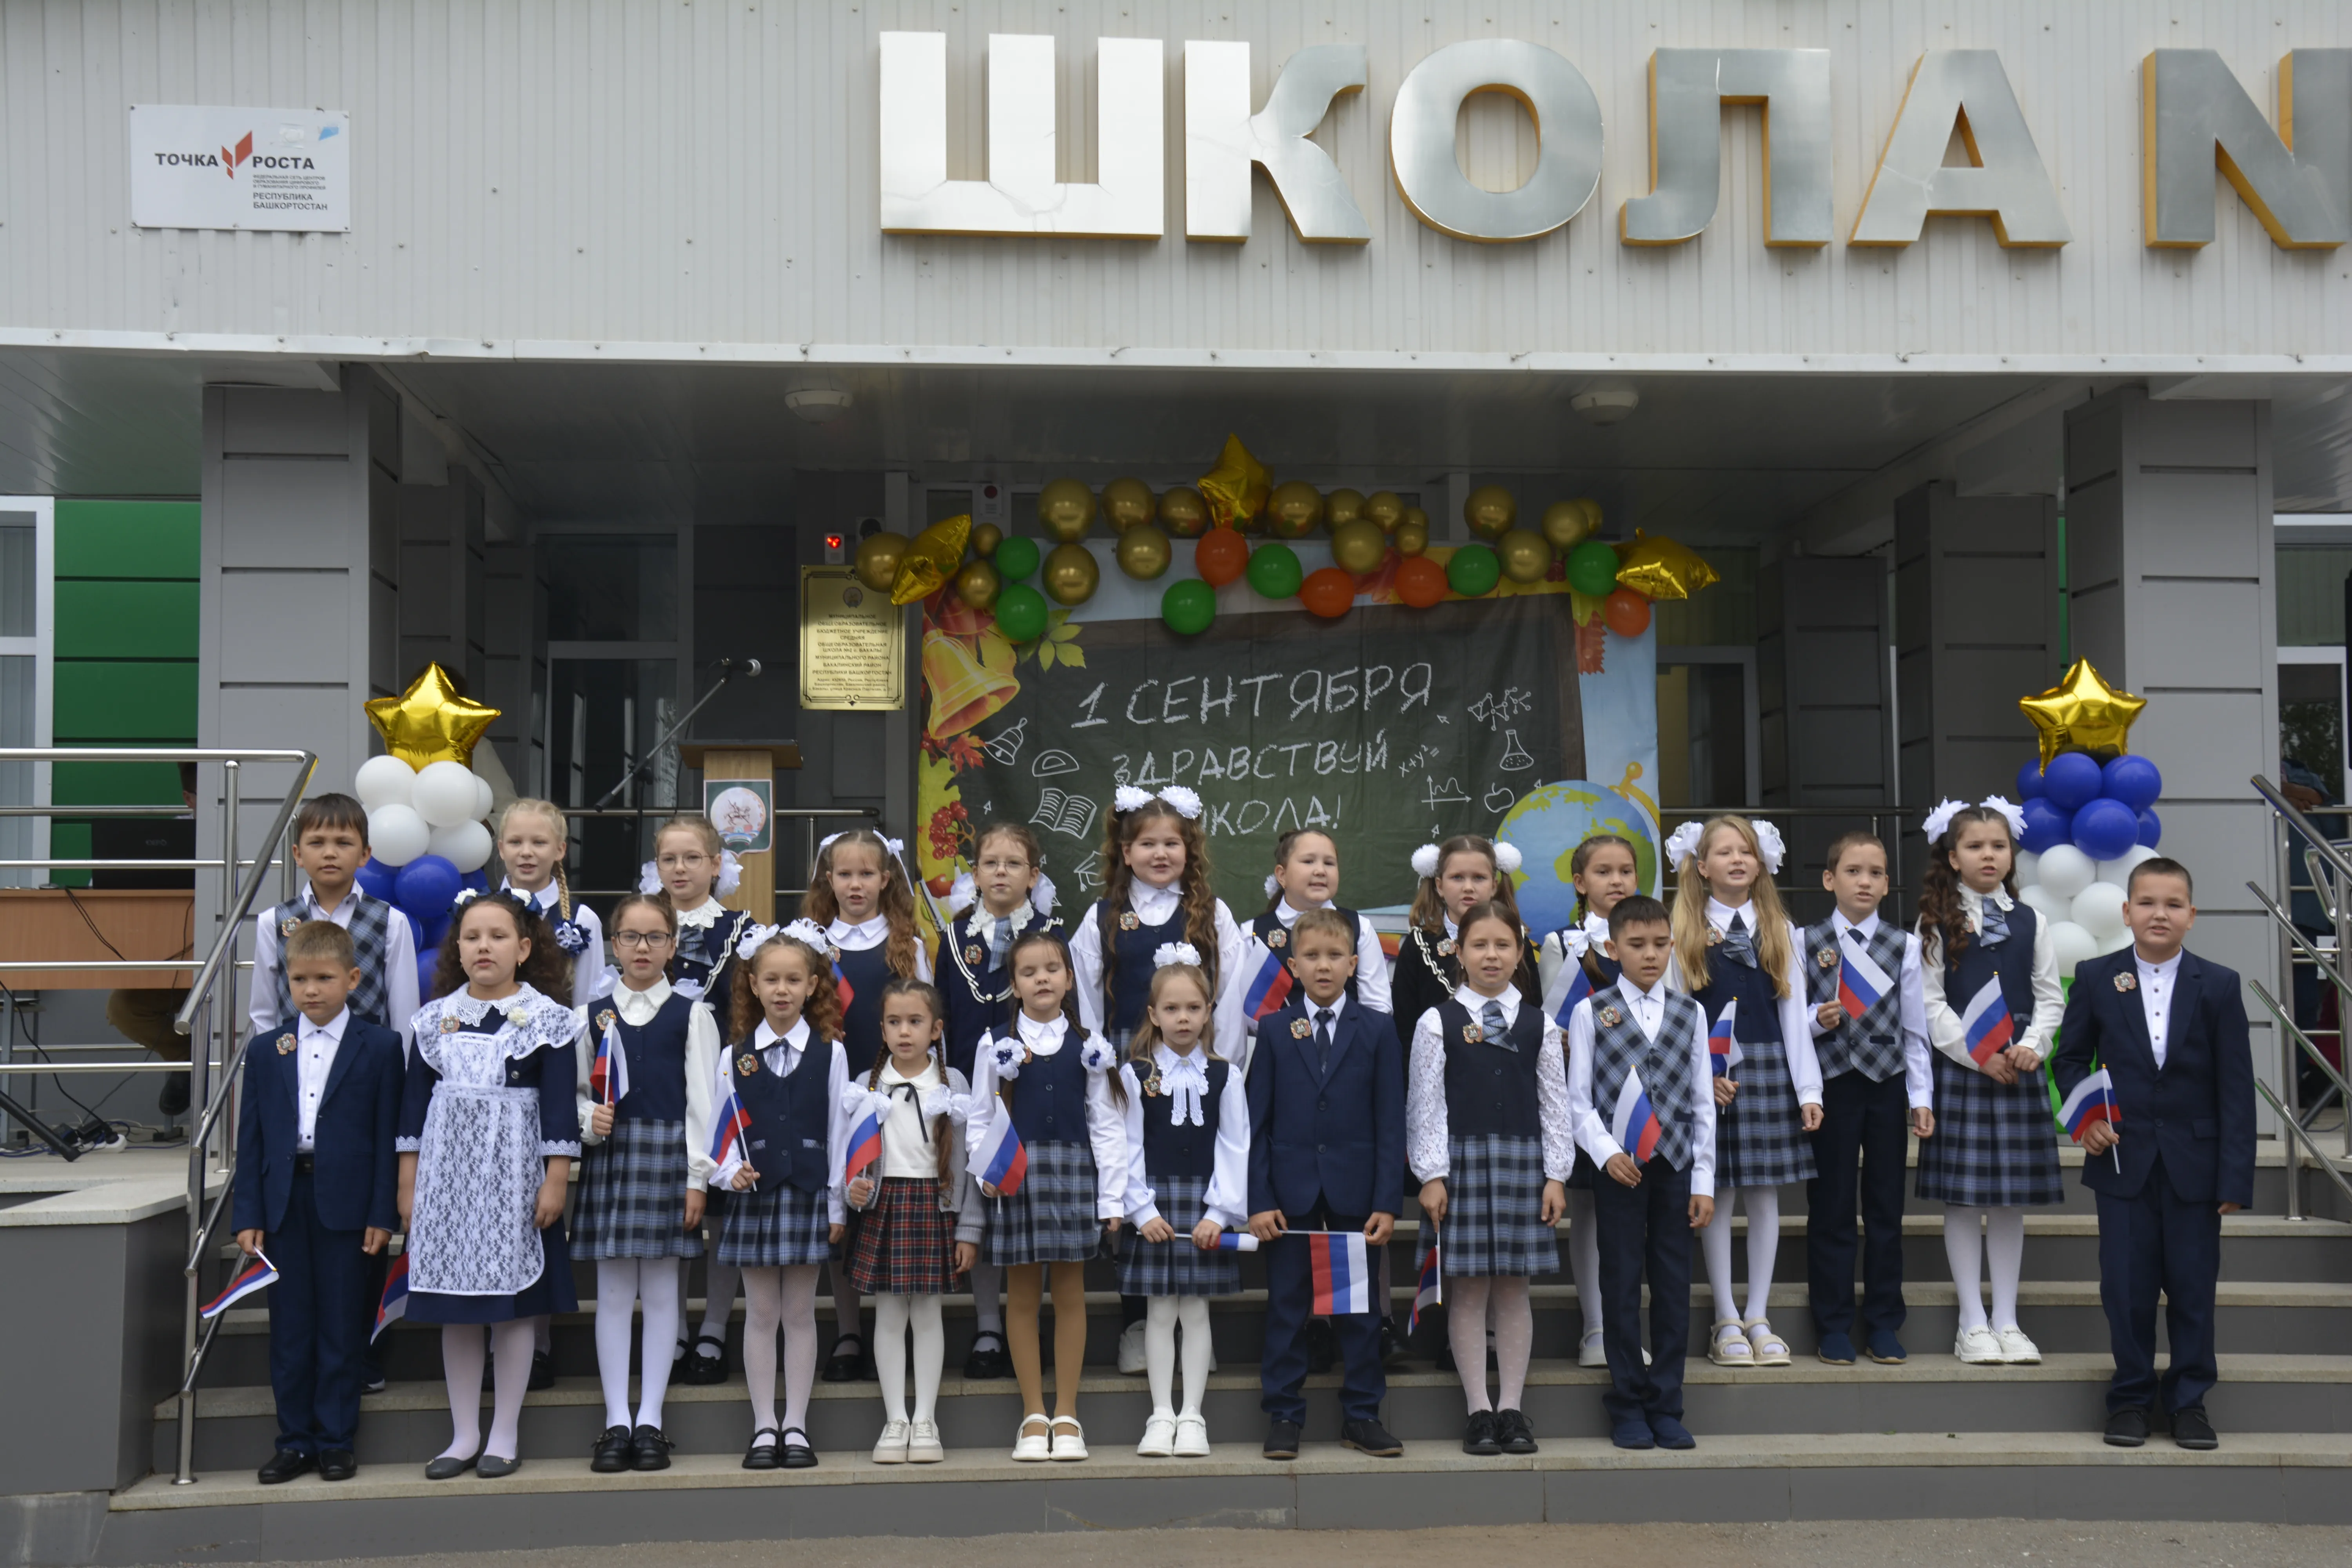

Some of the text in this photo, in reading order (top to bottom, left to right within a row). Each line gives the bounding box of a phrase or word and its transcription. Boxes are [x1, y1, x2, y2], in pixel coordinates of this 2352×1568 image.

[155, 153, 315, 170] ТОЧКА РОСТА
[879, 31, 2074, 249] ШКОЛА
[253, 201, 328, 211] БАШКОРТОСТАН
[1071, 662, 1432, 728] 1 СЕНТЯБРЯ
[1112, 728, 1389, 786] ЗДРАВСТВУЙ
